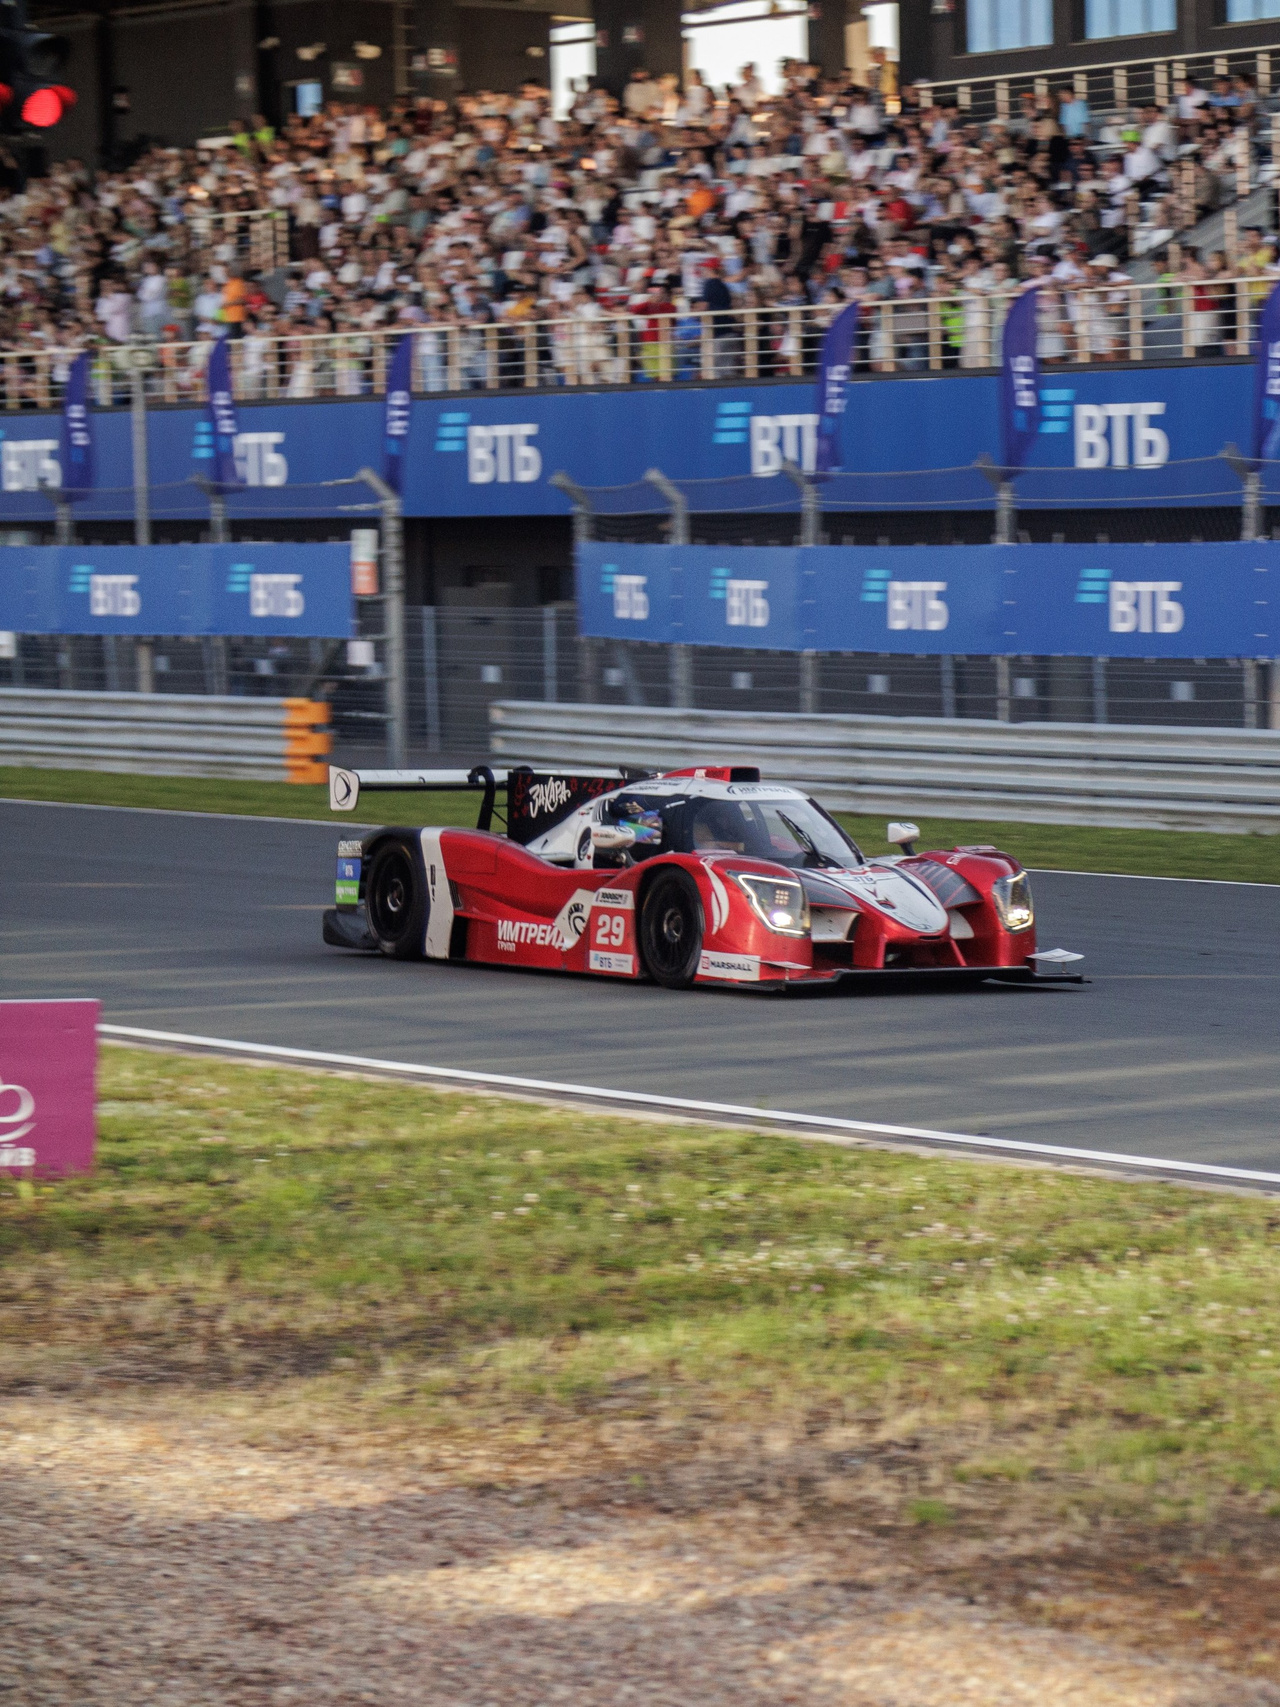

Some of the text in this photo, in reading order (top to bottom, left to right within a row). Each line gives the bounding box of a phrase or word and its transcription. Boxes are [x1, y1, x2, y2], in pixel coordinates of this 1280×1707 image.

[467, 423, 542, 484] ВТБ
[1073, 402, 1170, 470] ВТБ
[90, 574, 141, 616] ВТБ
[250, 573, 304, 617] ВТБ
[613, 574, 649, 620] ВТБ
[725, 579, 769, 628] ВТБ
[887, 581, 949, 631] ВТБ
[1109, 581, 1185, 634] ВТБ
[497, 919, 568, 953] ИМТРЕЙД
[595, 914, 625, 947] 29
[710, 960, 753, 972] MARSHALL
